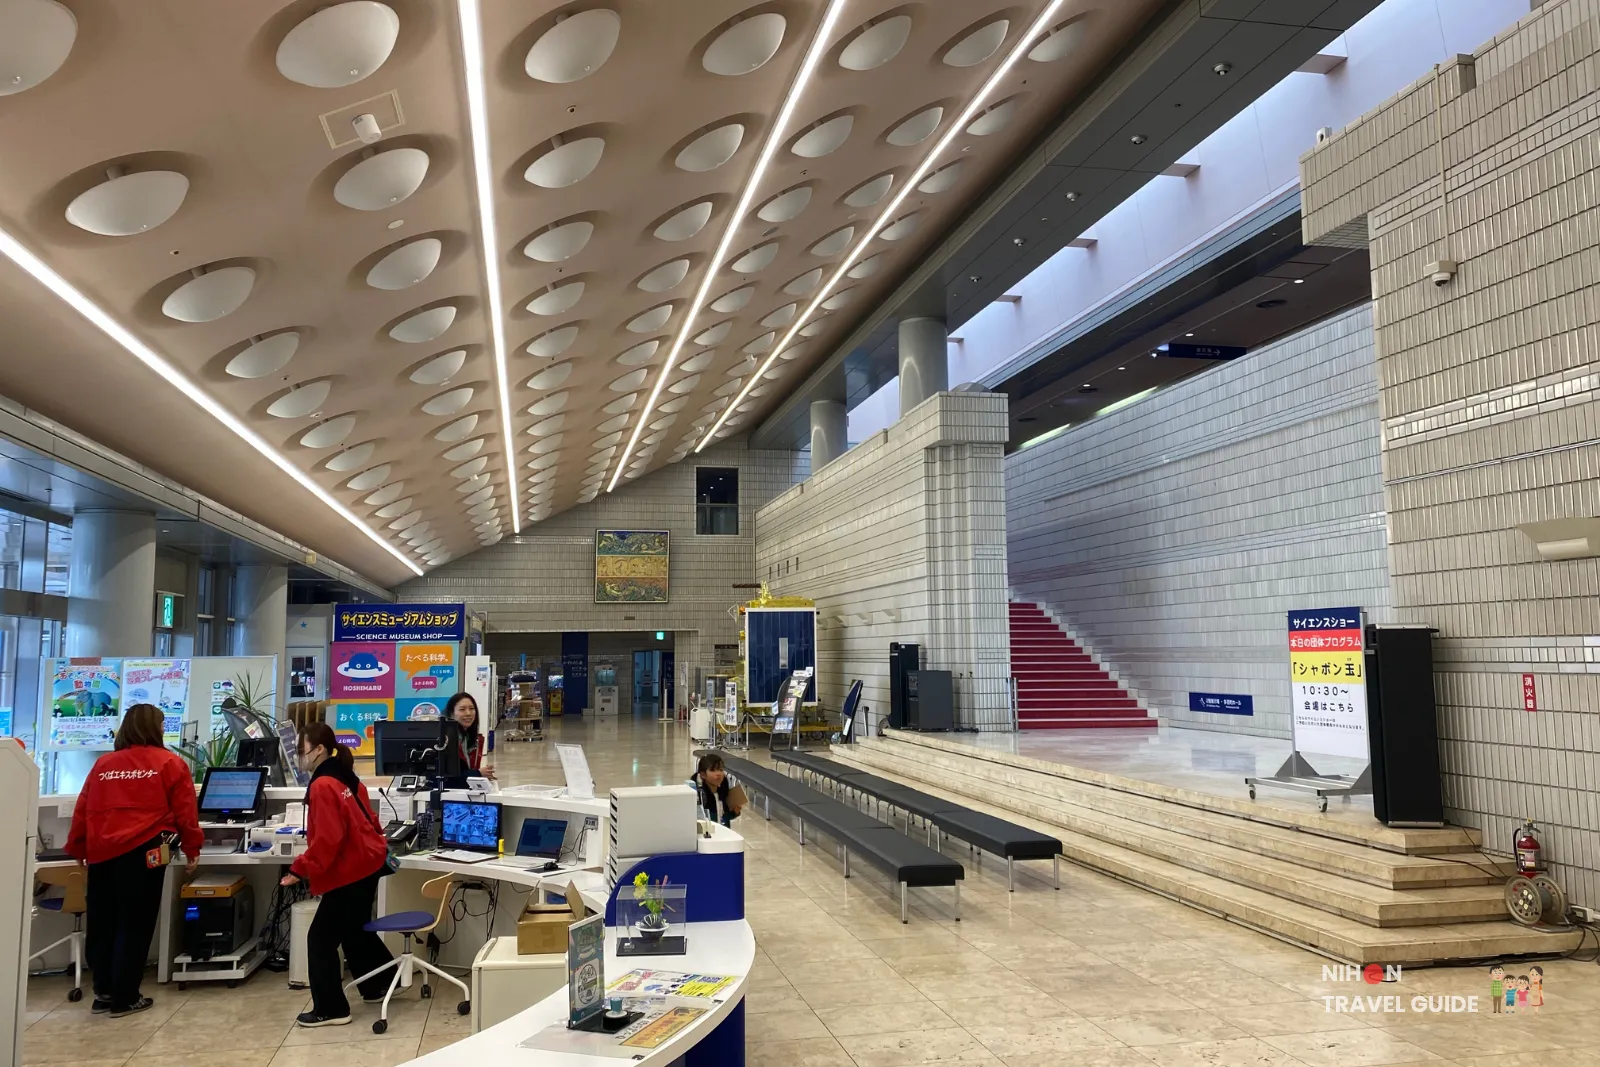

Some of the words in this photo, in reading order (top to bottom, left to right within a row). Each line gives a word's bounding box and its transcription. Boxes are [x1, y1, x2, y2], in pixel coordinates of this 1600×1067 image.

[341, 611, 459, 628] サイエンスミュージアムショップ
[1293, 617, 1356, 629] サイエンスショー
[1290, 637, 1361, 648] 本日の団体プログラム
[405, 653, 449, 662] たべる科学。
[1293, 661, 1362, 677] 「シャボン玉」
[1304, 701, 1354, 712] 会場はこちら
[98, 769, 158, 781] つくばエキスポセンター
